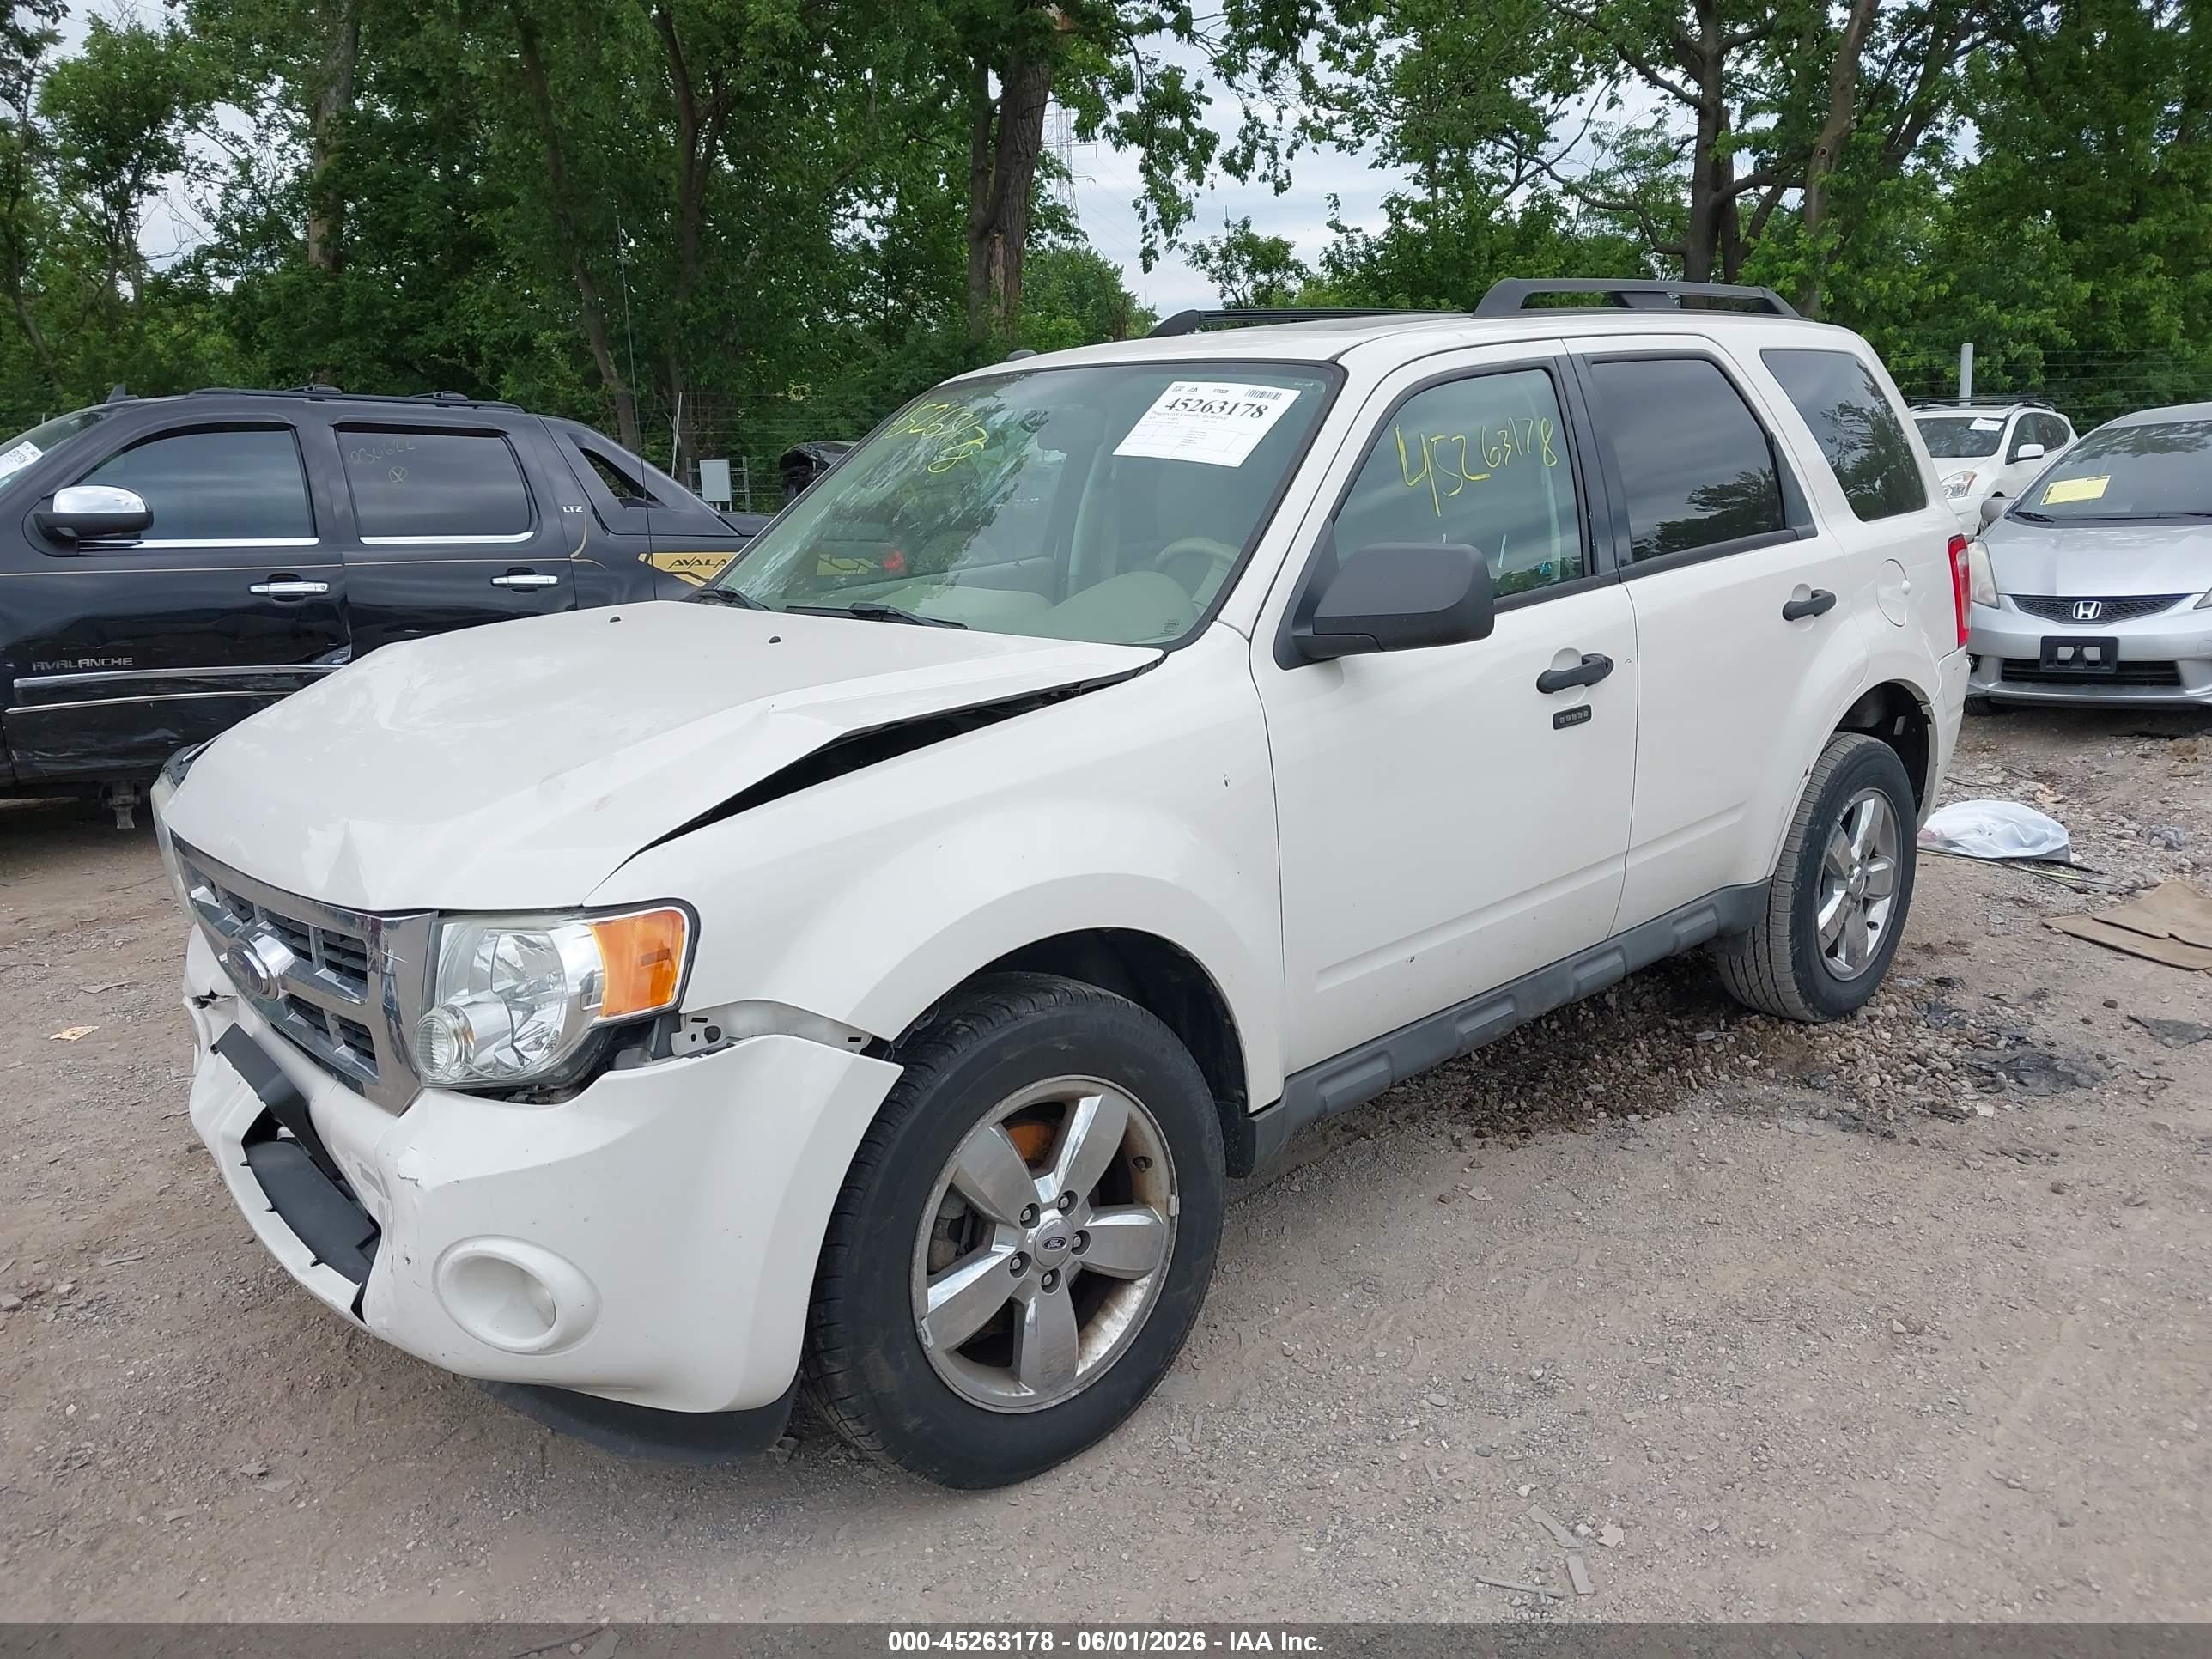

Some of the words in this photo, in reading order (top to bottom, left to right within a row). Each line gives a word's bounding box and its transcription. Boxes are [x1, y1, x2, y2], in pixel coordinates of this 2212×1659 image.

[1164, 398, 1269, 419] 45263178
[1395, 417, 1558, 517] 45263178
[562, 505, 584, 514] LTZ
[32, 656, 133, 672] AVALANCHE
